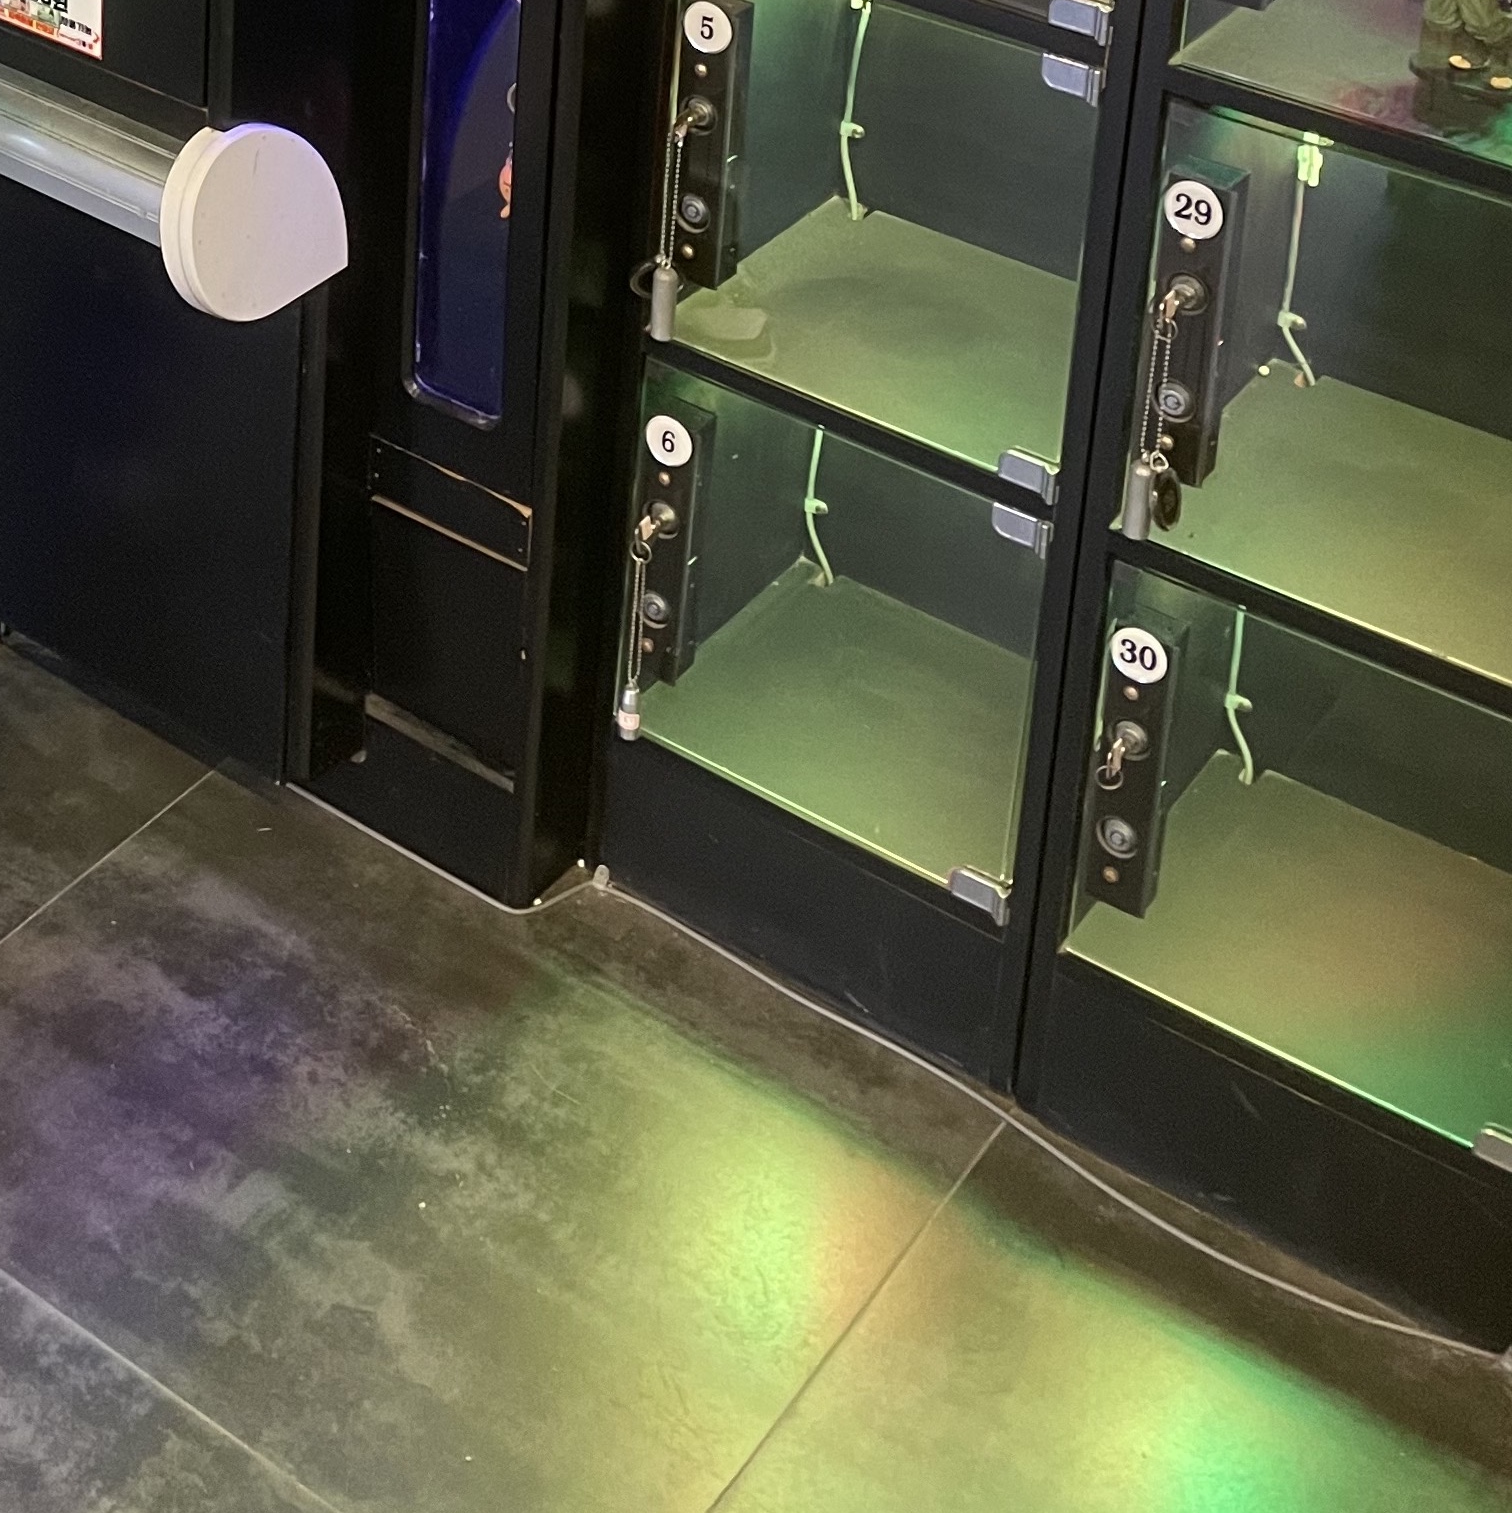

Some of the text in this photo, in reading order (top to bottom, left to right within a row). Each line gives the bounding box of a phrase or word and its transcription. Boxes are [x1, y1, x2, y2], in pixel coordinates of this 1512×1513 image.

[699, 16, 714, 42] 5
[1174, 193, 1213, 226] 29
[660, 429, 677, 454] 6
[1120, 645, 1159, 671] 30
